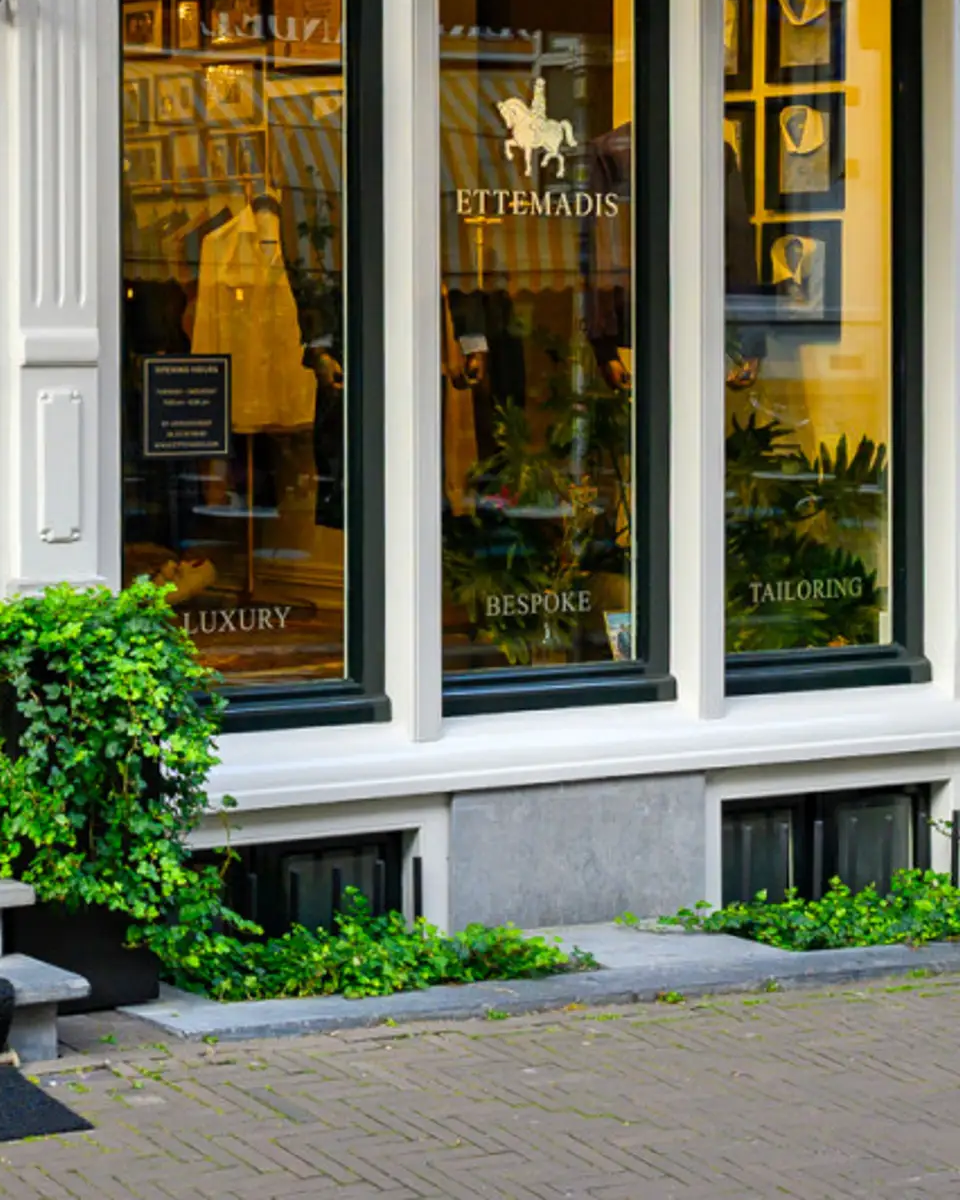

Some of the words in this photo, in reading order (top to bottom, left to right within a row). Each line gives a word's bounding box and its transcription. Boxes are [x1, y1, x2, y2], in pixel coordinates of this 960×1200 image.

[456, 188, 619, 218] ETTEMADIS
[485, 590, 592, 617] BESPOKE
[748, 576, 863, 603] TAILORING
[183, 606, 292, 635] LUXURY
